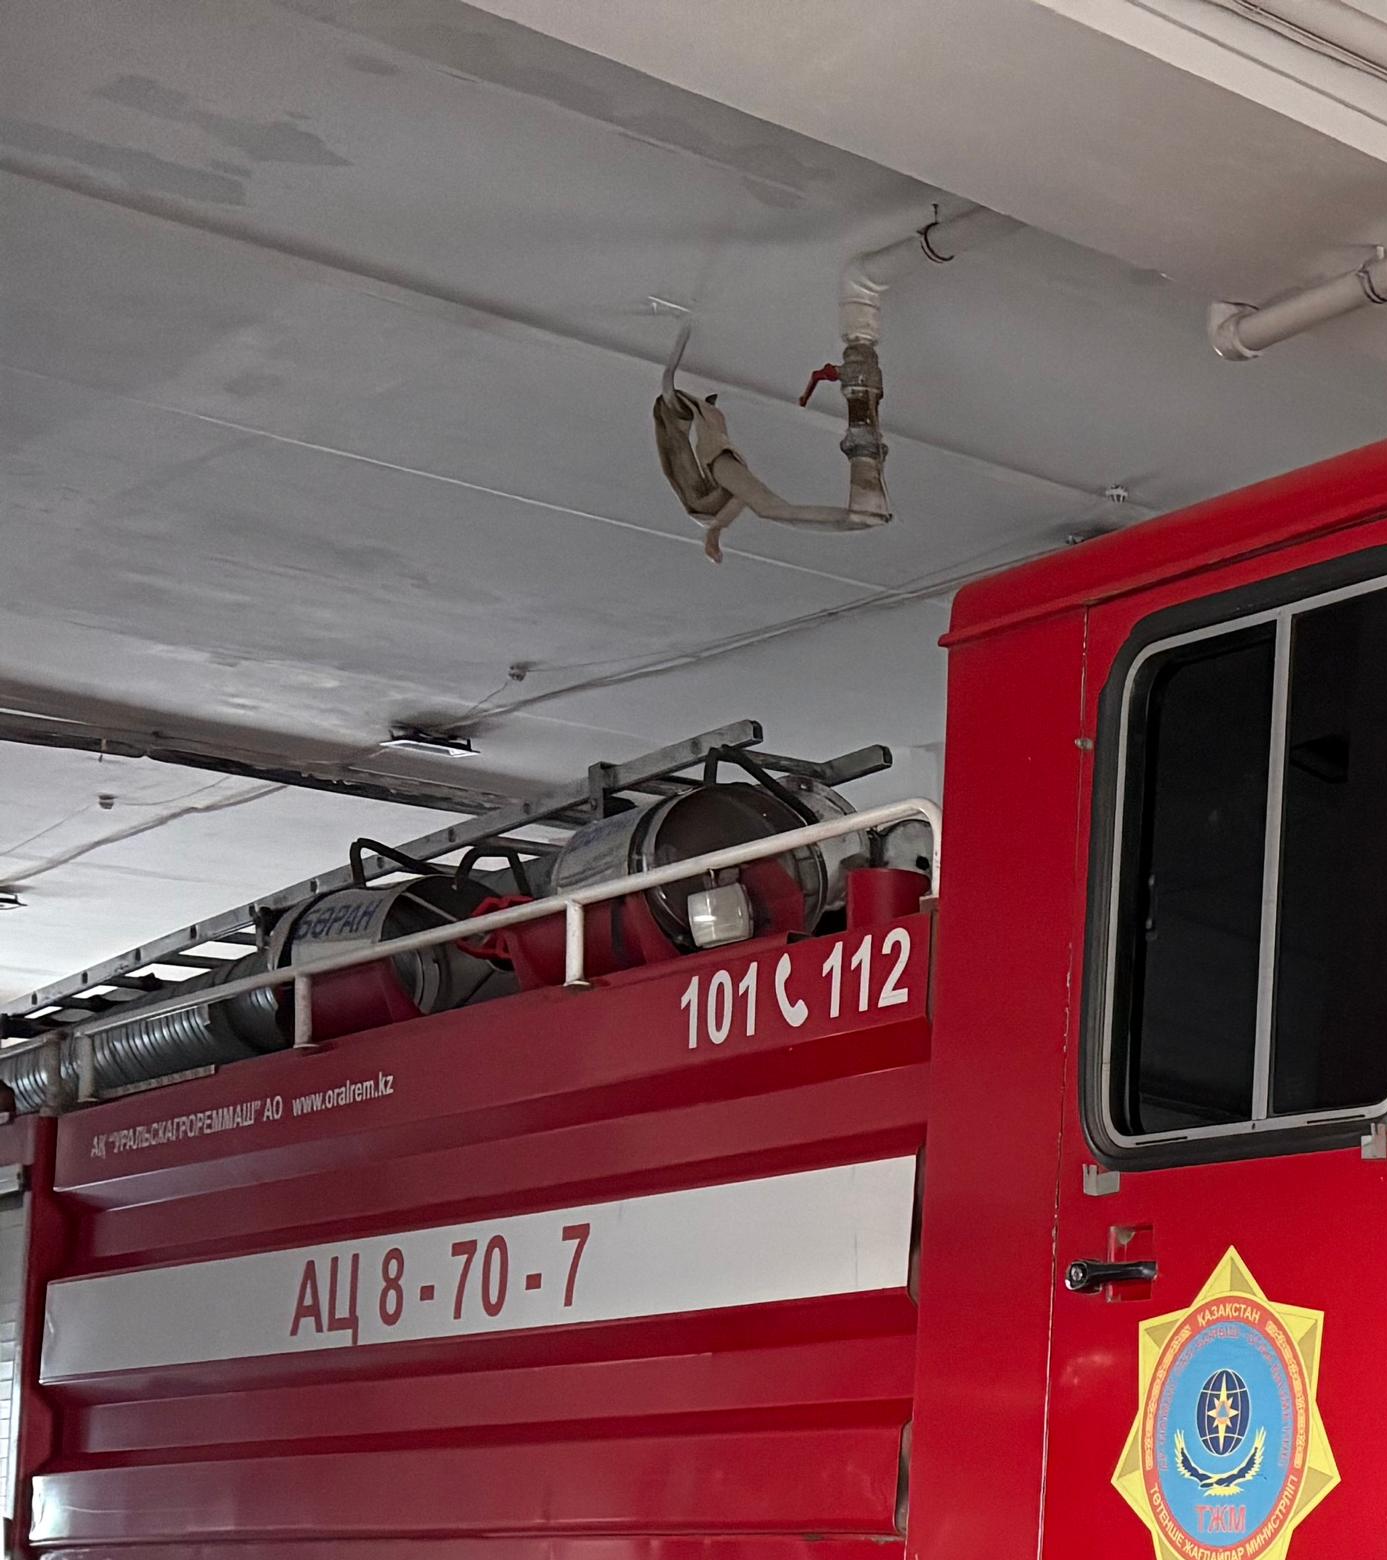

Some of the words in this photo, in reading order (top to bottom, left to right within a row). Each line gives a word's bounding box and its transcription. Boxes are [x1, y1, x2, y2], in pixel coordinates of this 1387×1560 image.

[680, 961, 758, 1049] 101
[822, 927, 911, 1018] 112
[264, 1095, 283, 1121] АО
[292, 1072, 394, 1117] www.oralrem.kz
[290, 1253, 360, 1345] АЦ
[1195, 1504, 1247, 1533] ТЖМ
